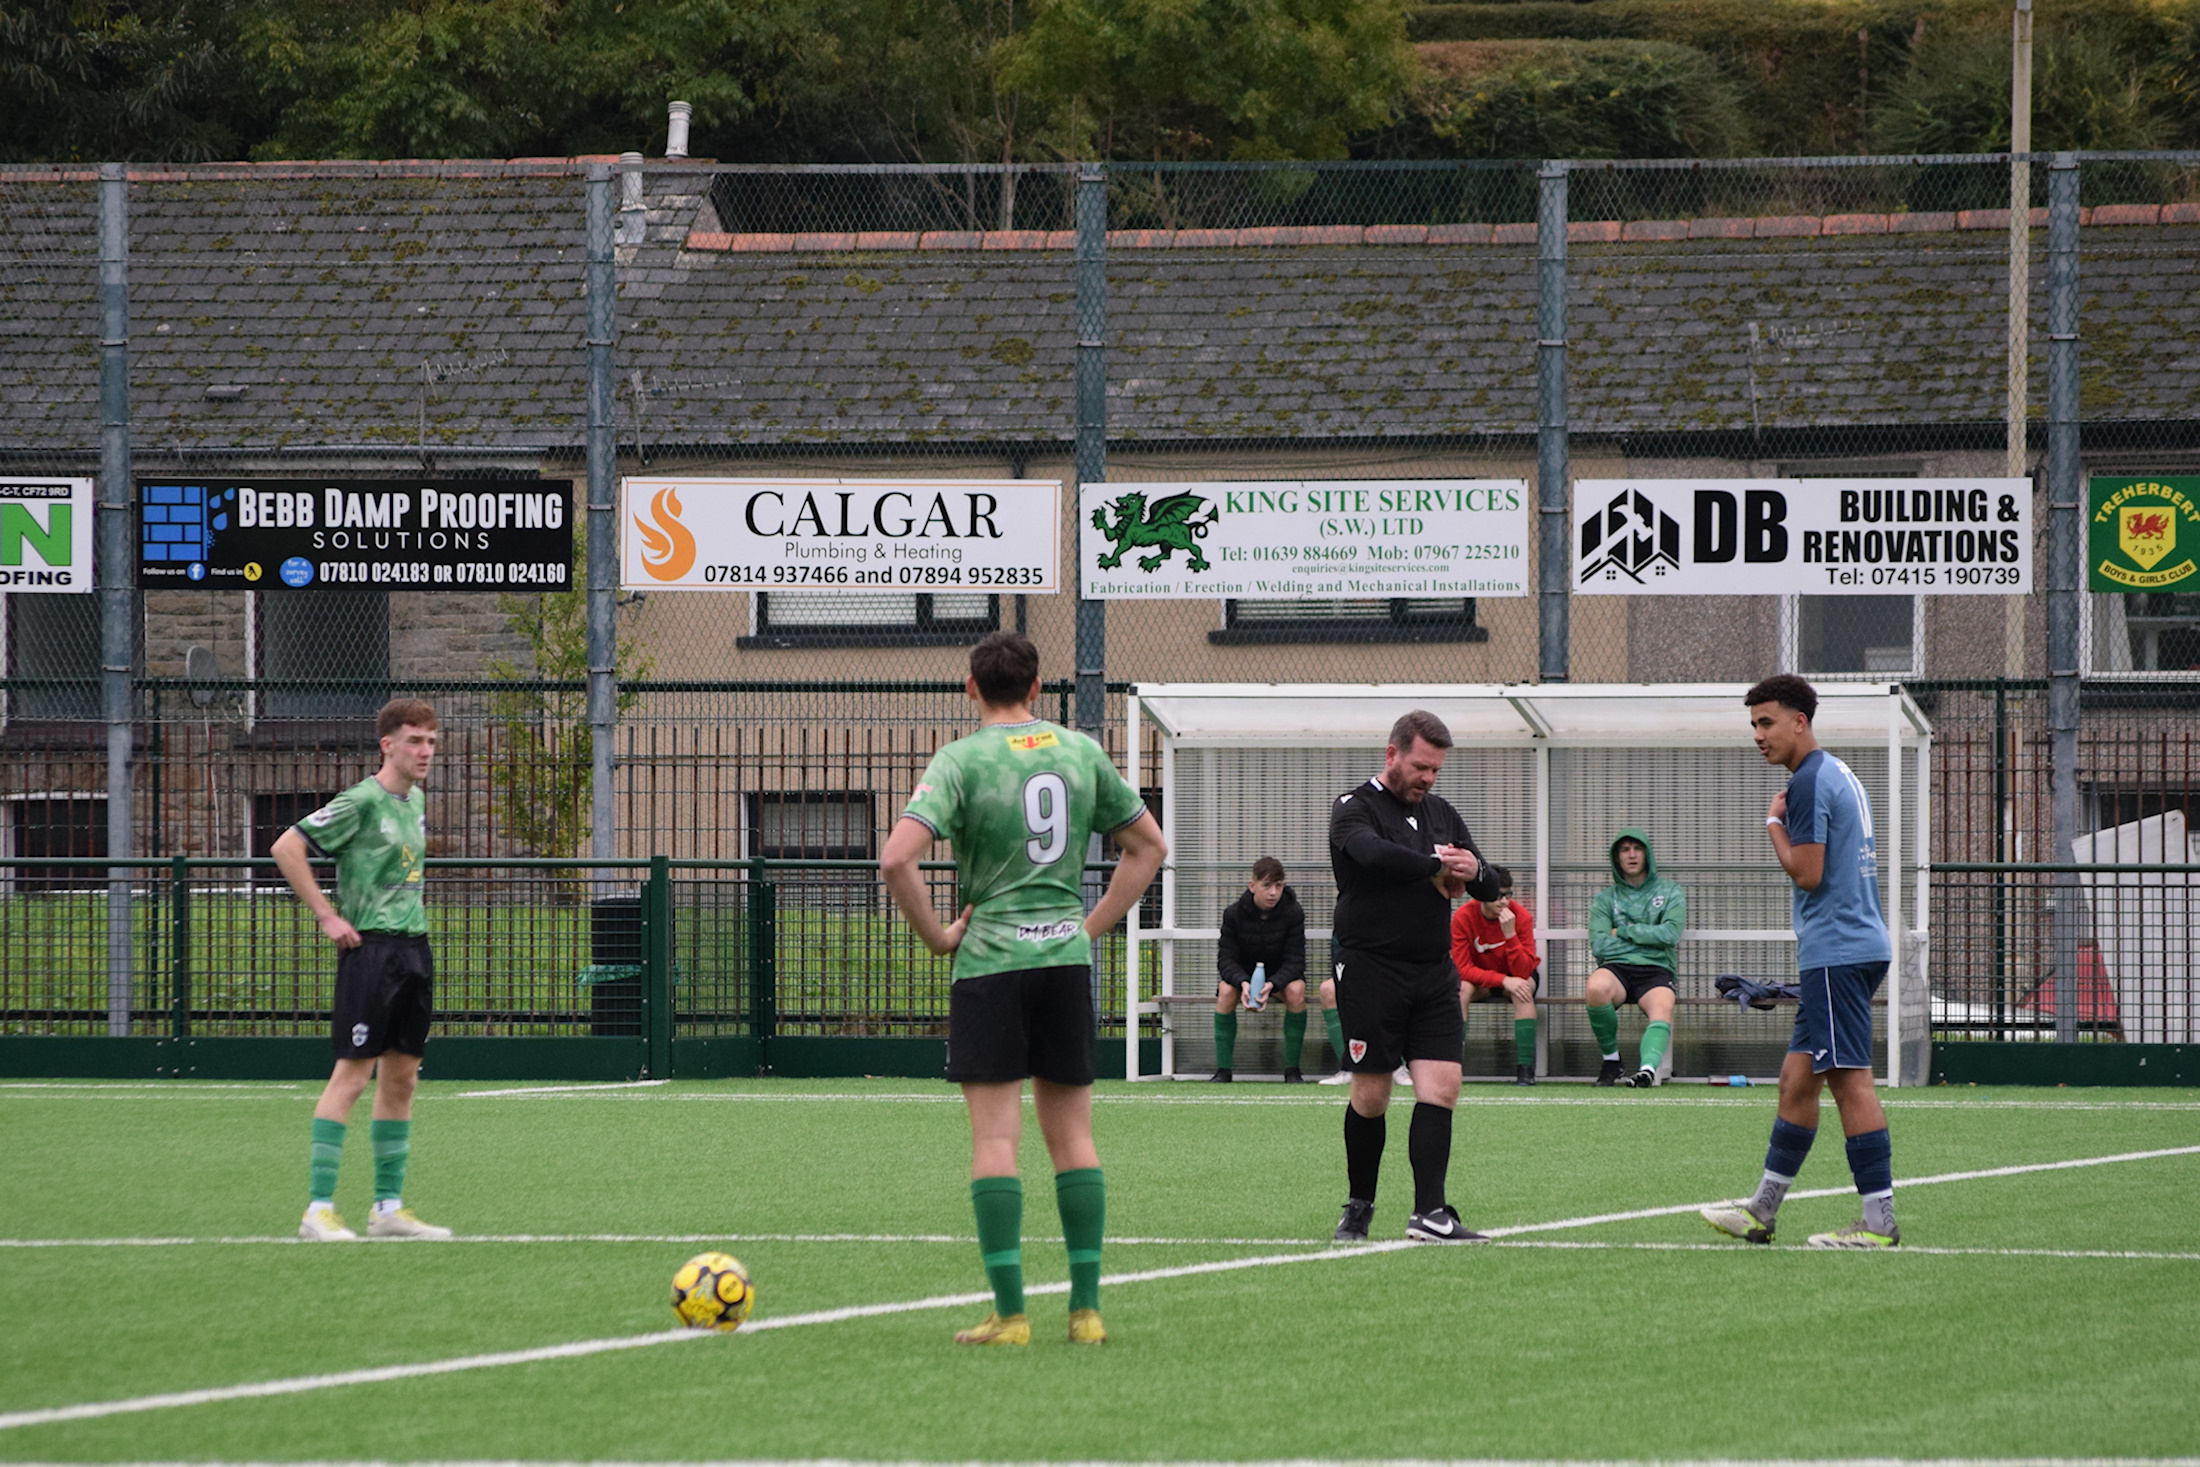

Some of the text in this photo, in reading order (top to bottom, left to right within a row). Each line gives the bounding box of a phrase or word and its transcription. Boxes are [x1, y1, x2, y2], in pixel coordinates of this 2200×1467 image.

[22, 487, 47, 496] CF72
[48, 487, 69, 496] 9RD
[1227, 489, 1519, 512] KING SITE SERVICES
[1841, 489, 2019, 522] BUILDING &
[2095, 482, 2200, 523] TREHERBERT
[746, 491, 1003, 538] CALGAR
[0, 503, 72, 566] N
[1320, 519, 1423, 537] (S.W.) LTD
[1694, 490, 1788, 563] DB
[313, 531, 489, 549] SOLUTIONS
[1804, 530, 2019, 563] RENOVATIONS
[2133, 544, 2163, 556] 1935
[786, 542, 961, 563] Plumbing & Heating
[1220, 545, 1519, 561] Tel: 01639 884669 Mob: 07967 225210
[320, 562, 367, 582] 07810
[372, 562, 429, 582] 024183
[457, 563, 504, 583] 07810
[509, 563, 565, 583] 024160
[705, 566, 1042, 584] 07814 937466 and 07894 952835
[1292, 563, 1449, 575] enquiries@kingsiteservices.com
[1826, 568, 2020, 584] Tel: 07415 190739
[2104, 564, 2192, 584] BOYS & GIRLS CLUB
[1091, 582, 1170, 593] Fabrication
[1185, 581, 1242, 592] Erection
[1257, 581, 1312, 595] Welding
[1318, 580, 1342, 592] and
[1349, 580, 1427, 591] Mechanical
[1433, 580, 1520, 591] Installations
[1023, 772, 1069, 865] 9
